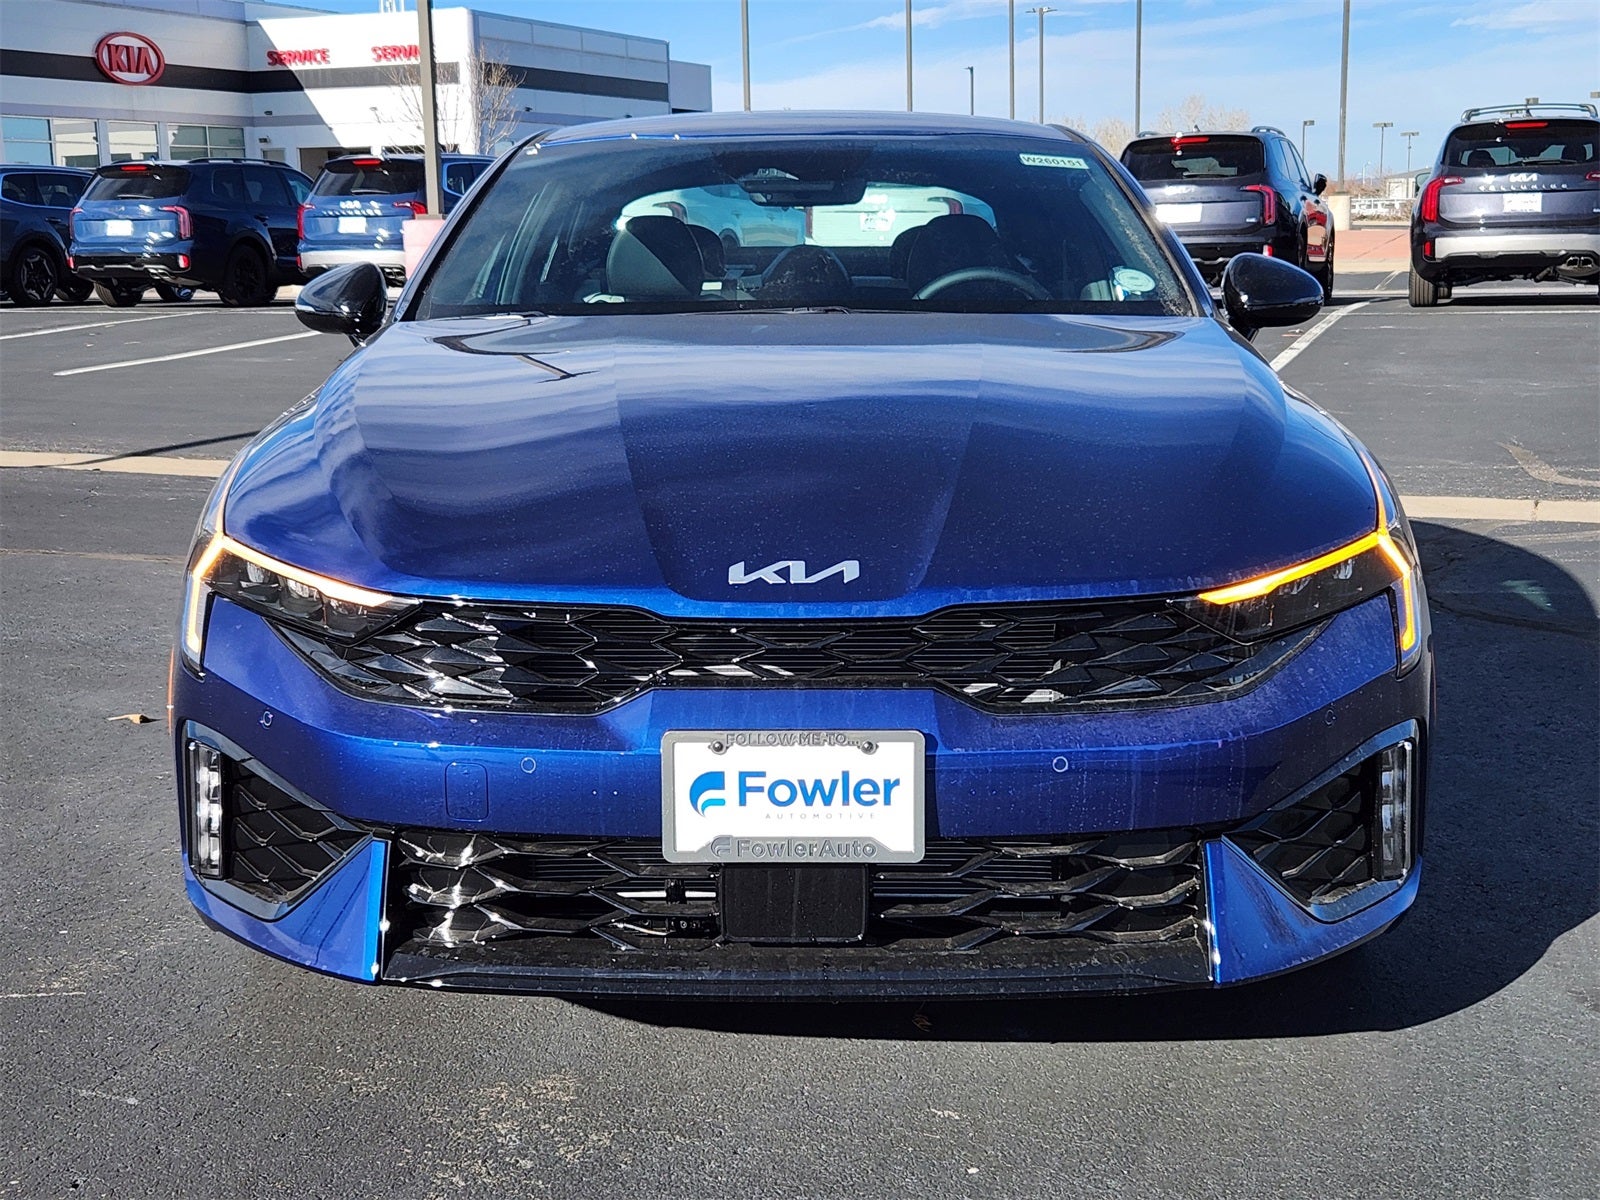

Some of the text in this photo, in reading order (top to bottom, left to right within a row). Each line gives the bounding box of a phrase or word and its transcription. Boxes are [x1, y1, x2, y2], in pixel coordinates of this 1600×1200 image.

[106, 44, 156, 76] KIA
[267, 49, 330, 66] SERVICE
[371, 45, 420, 62] SERVI
[1022, 156, 1083, 167] W260151
[728, 560, 860, 585] KIA
[726, 733, 796, 746] FOLLOW
[798, 733, 823, 746] ME
[738, 770, 900, 807] Fowler
[765, 812, 876, 820] AUTOMOTIVE
[736, 839, 878, 858] FowlerAuto
